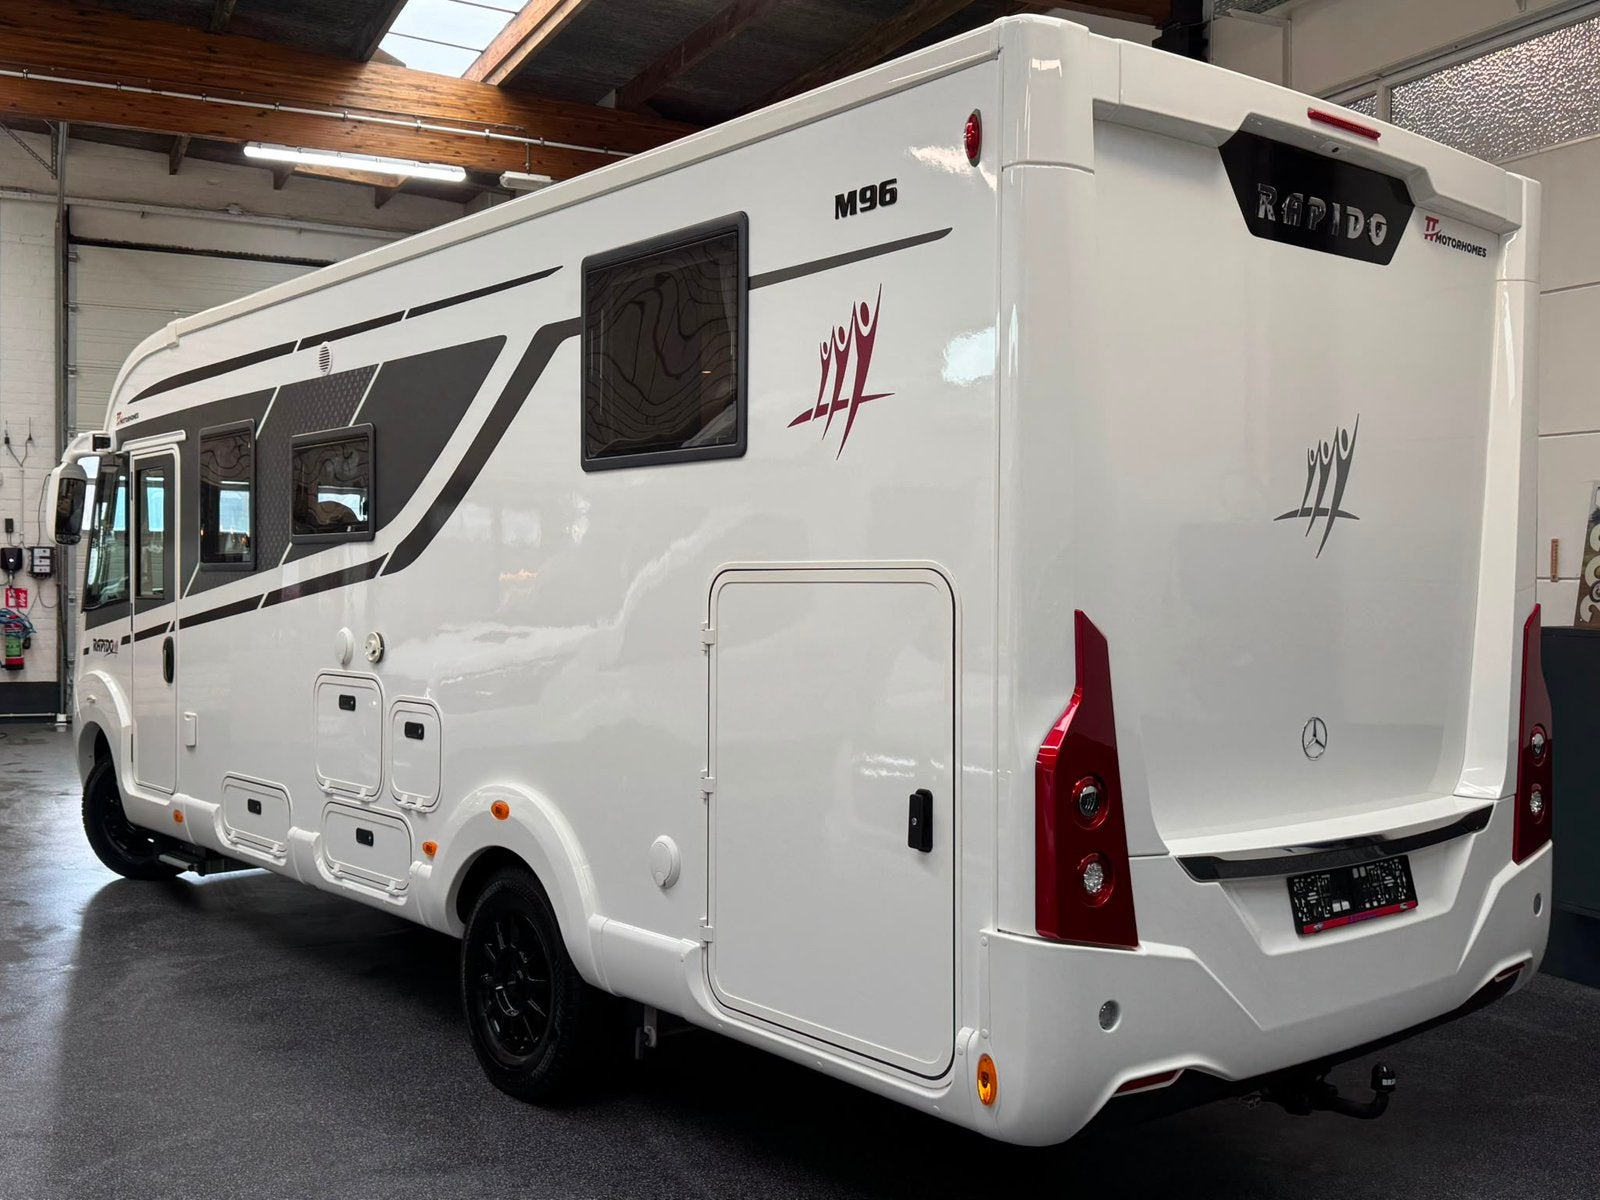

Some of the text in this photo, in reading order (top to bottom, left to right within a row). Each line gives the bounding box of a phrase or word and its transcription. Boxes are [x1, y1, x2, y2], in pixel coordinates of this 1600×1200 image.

[834, 177, 898, 220] M96
[1256, 182, 1388, 247] RAPIDO
[1434, 232, 1488, 258] MOTORHOMES
